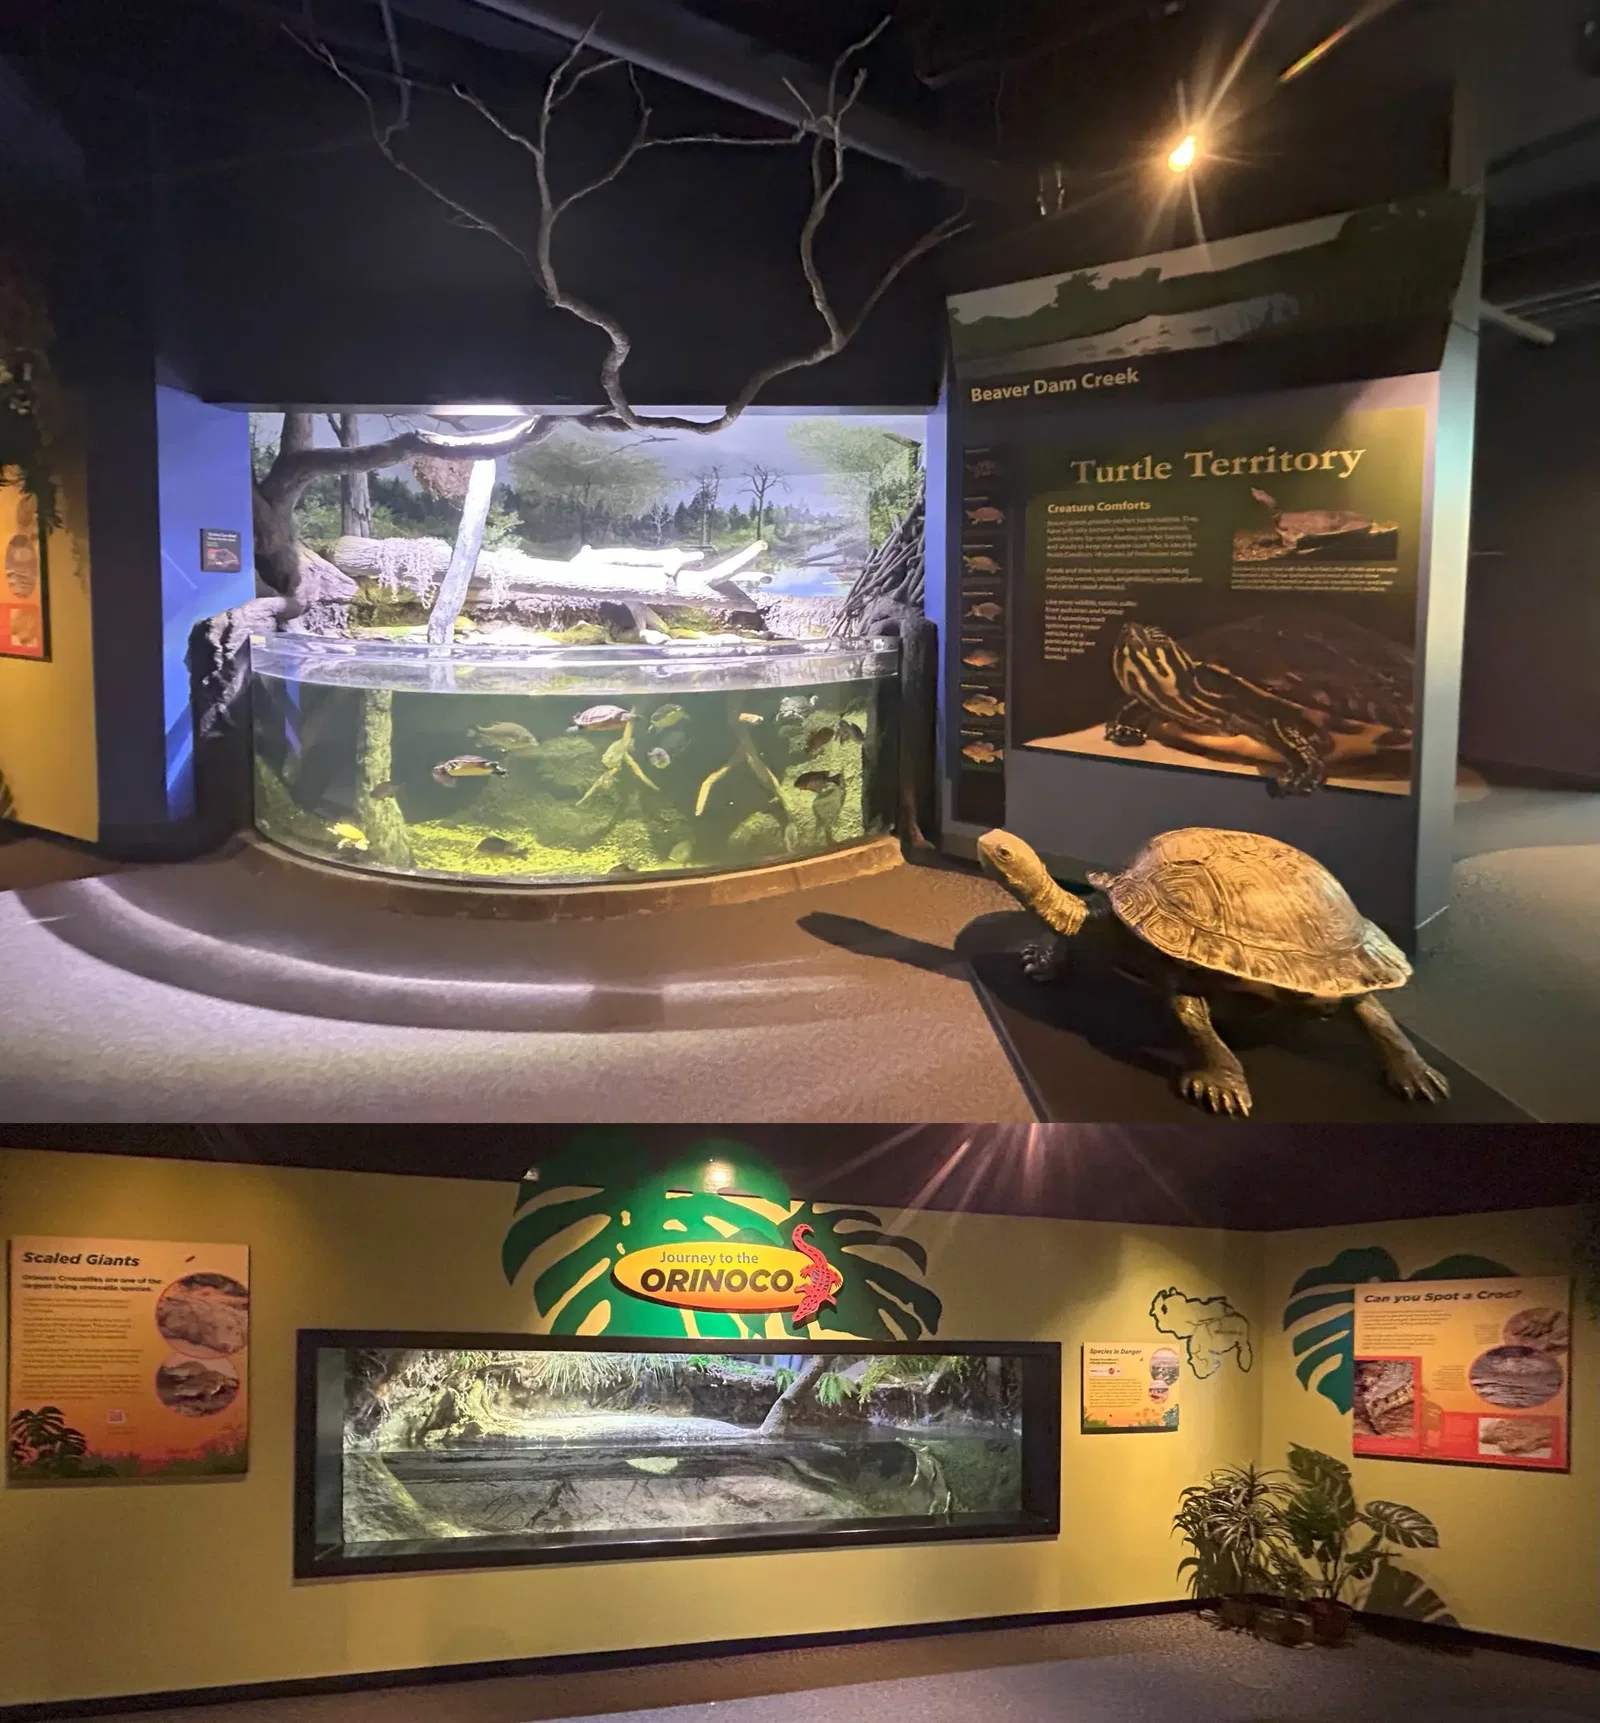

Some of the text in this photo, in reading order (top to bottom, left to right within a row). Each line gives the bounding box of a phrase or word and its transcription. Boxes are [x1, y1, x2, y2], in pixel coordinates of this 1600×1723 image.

[971, 367, 1139, 402] Beaver Dam Creek
[1070, 446, 1367, 484] Turtle Territory
[1047, 501, 1151, 514] Creature Comforts
[22, 1252, 140, 1267] Scaled Giants
[660, 1252, 759, 1266] Journey to the
[640, 1268, 794, 1293] ORINOCO
[1364, 1295, 1391, 1303] Can
[1394, 1295, 1421, 1304] you
[1423, 1292, 1459, 1302] Spot
[1477, 1290, 1523, 1300] Croc?
[1120, 1348, 1142, 1356] Danger
